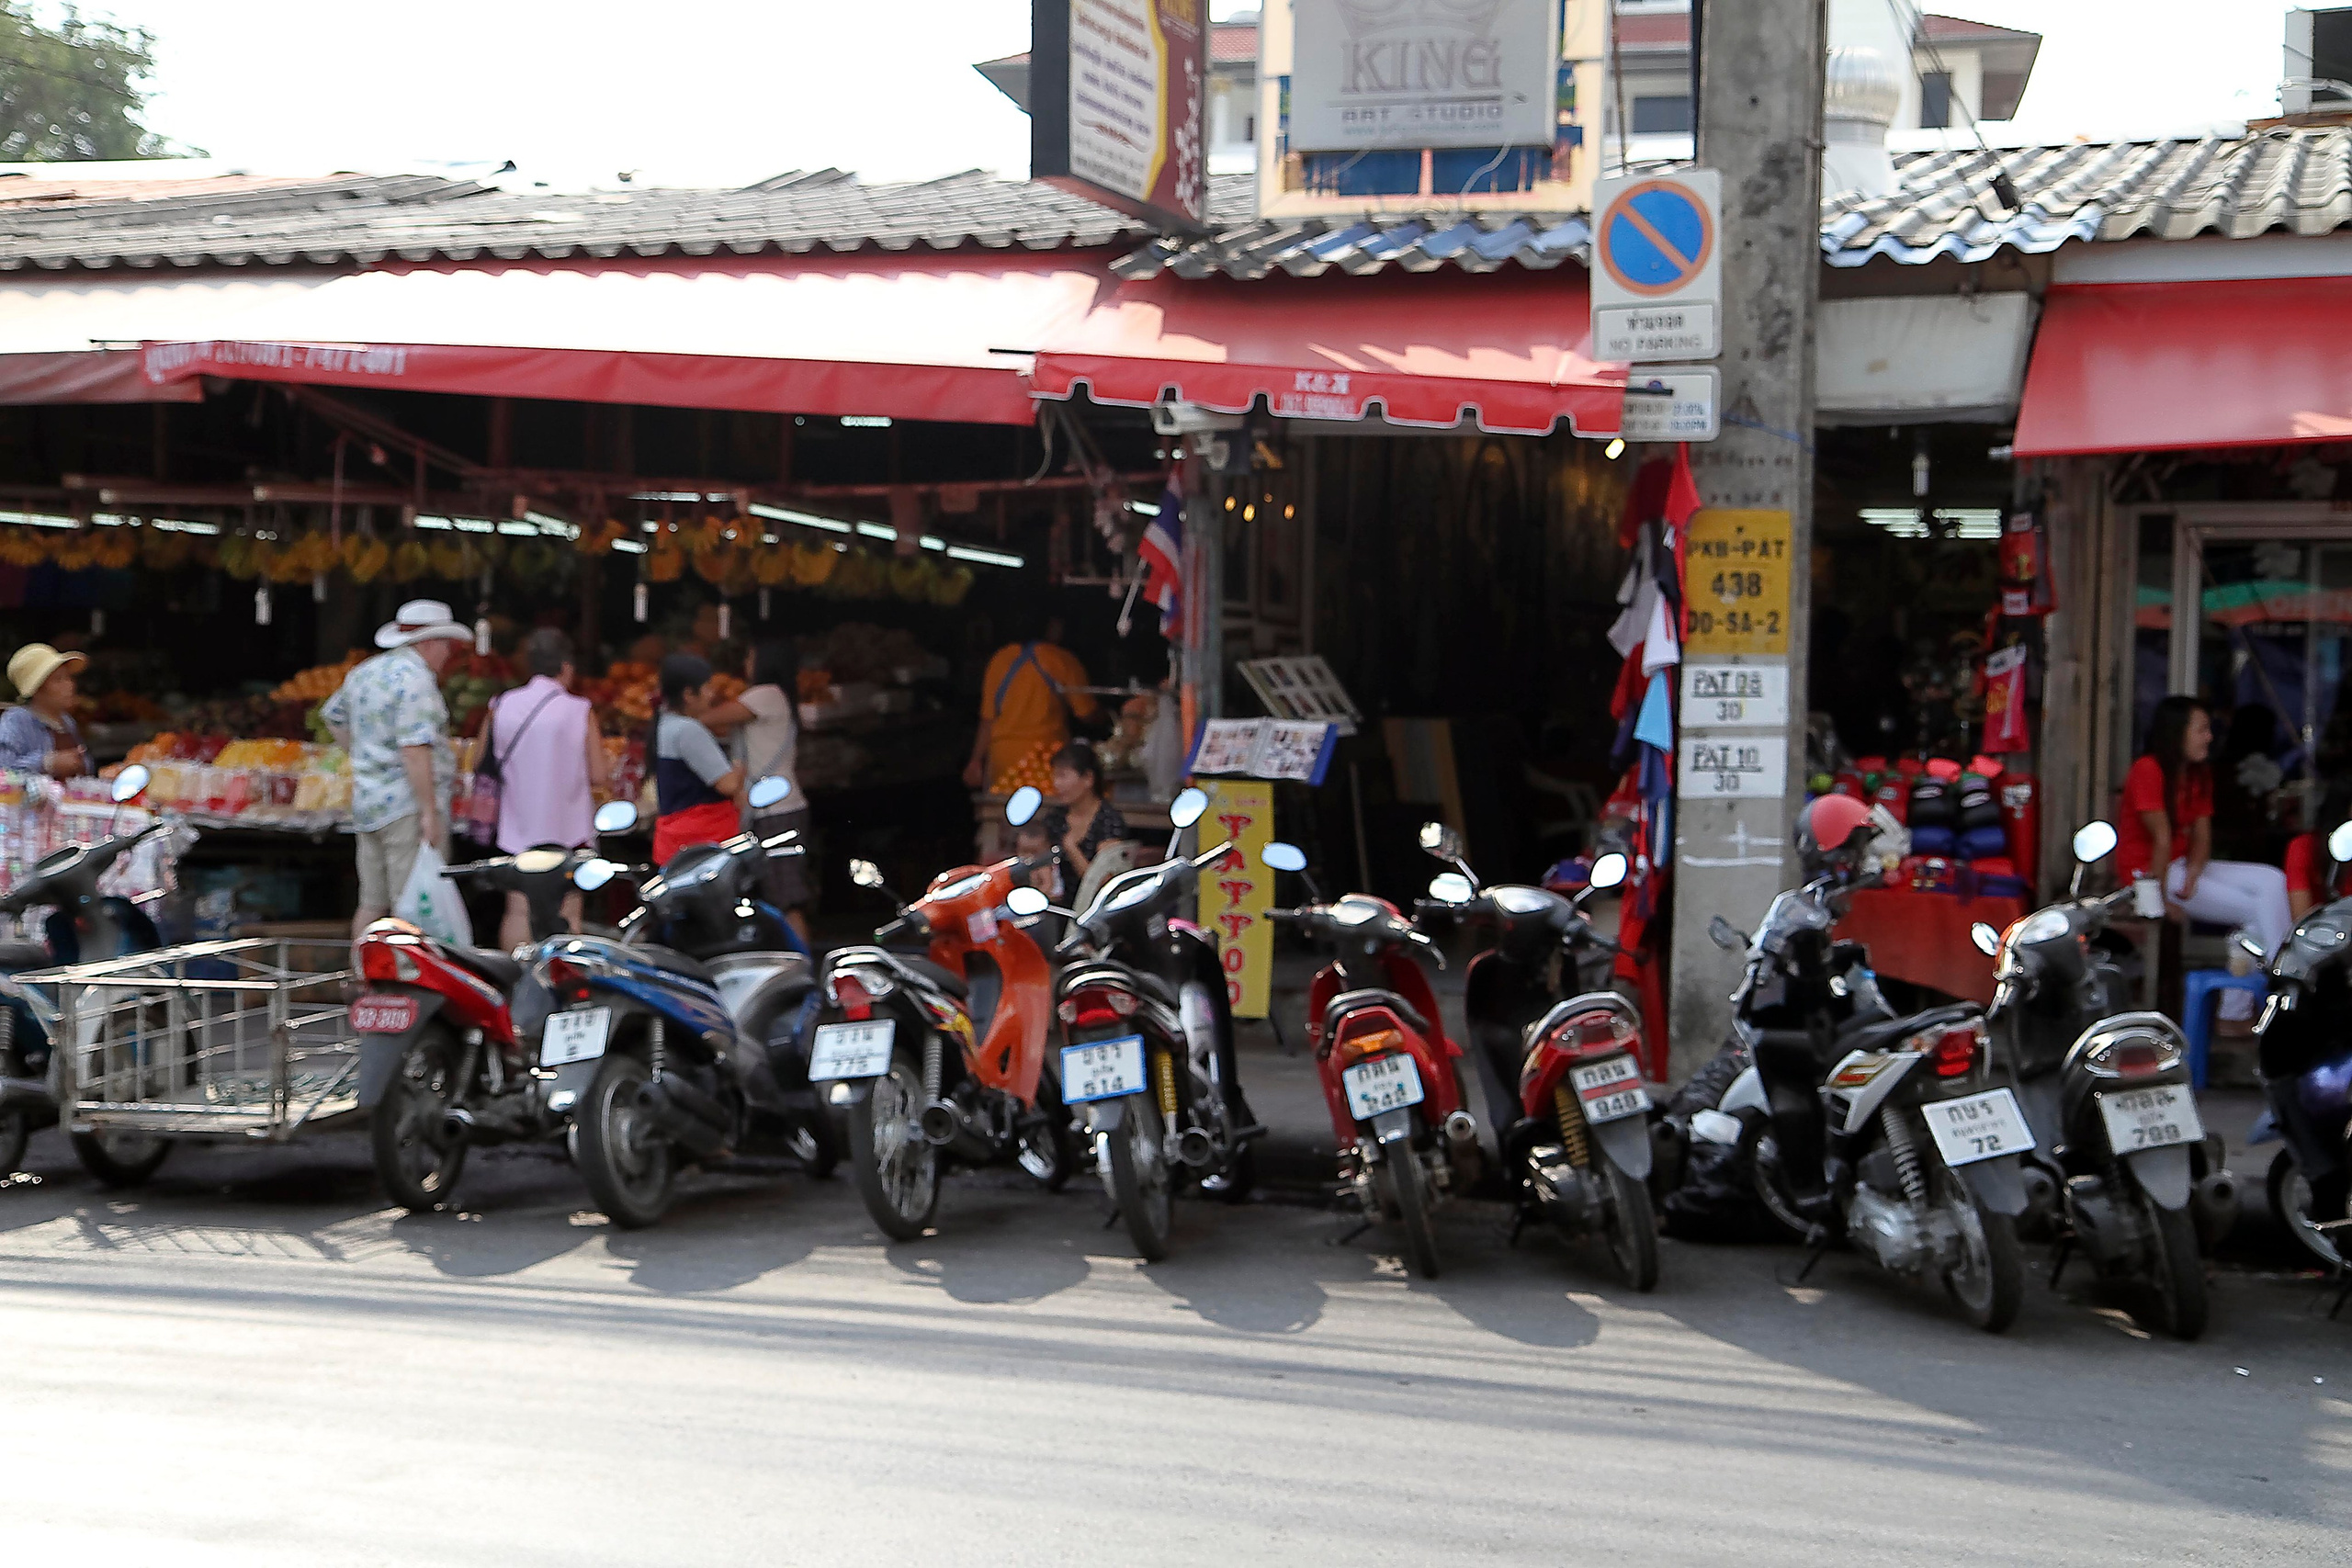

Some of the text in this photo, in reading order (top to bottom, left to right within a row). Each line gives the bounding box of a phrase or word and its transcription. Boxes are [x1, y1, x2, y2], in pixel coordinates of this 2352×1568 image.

[1340, 39, 1503, 94] KING
[1712, 571, 1762, 597] 438
[1693, 671, 1729, 694] PAT
[1693, 744, 1730, 767] PAT
[1217, 814, 1254, 1006] TATTOO
[1968, 1134, 2003, 1155] 72
